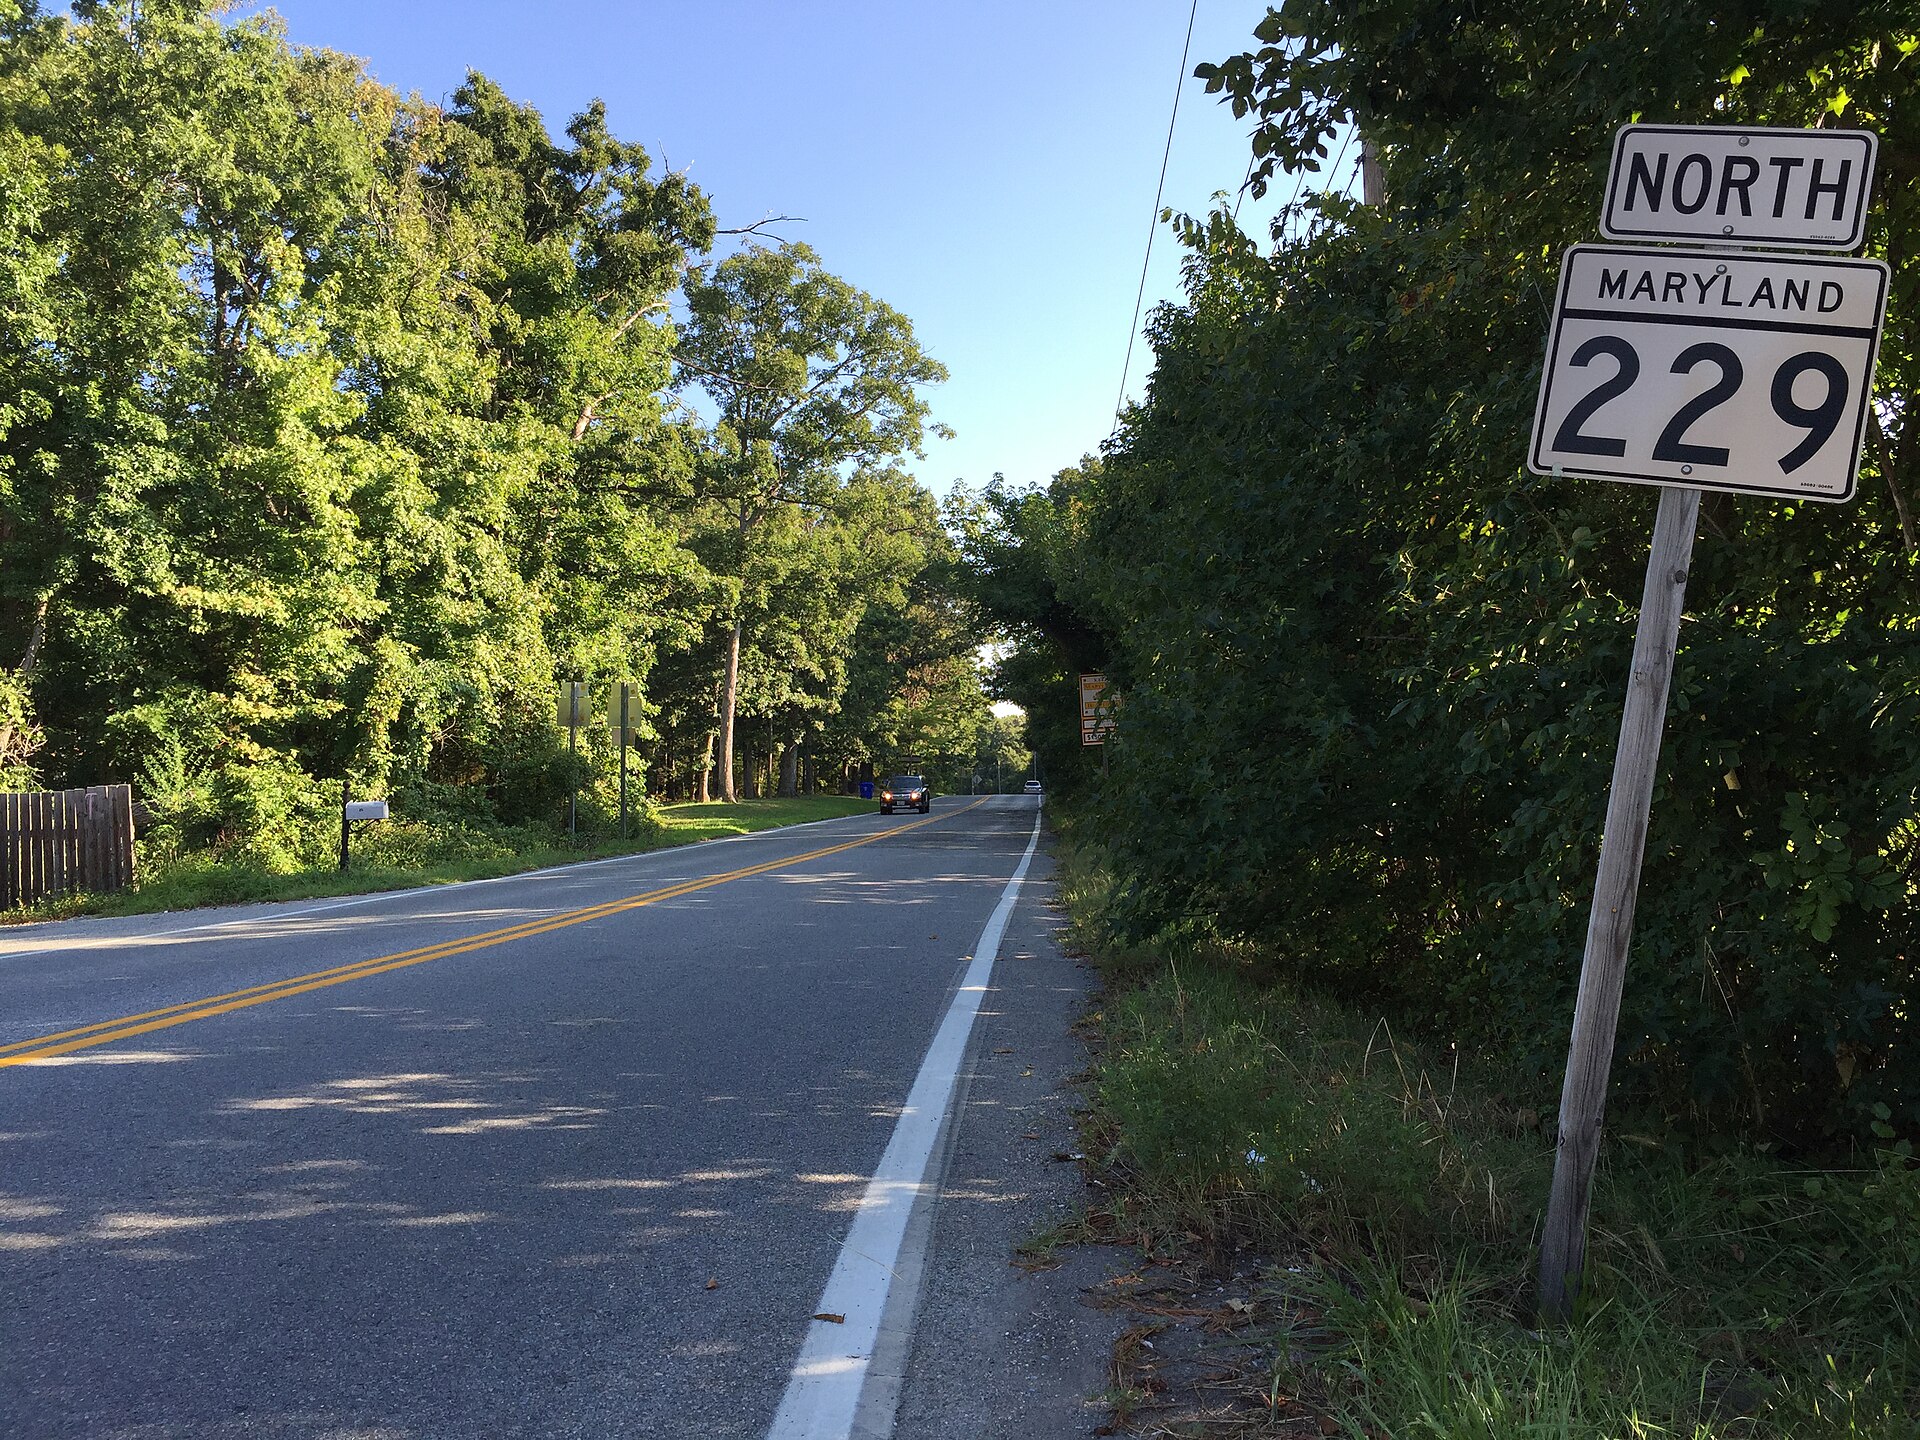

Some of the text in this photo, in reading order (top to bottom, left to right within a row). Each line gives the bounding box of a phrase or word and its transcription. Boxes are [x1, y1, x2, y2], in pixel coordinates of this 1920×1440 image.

[1623, 152, 1853, 221] NORTH
[1598, 268, 1844, 313] MARYLAND
[1551, 335, 1849, 475] 229
